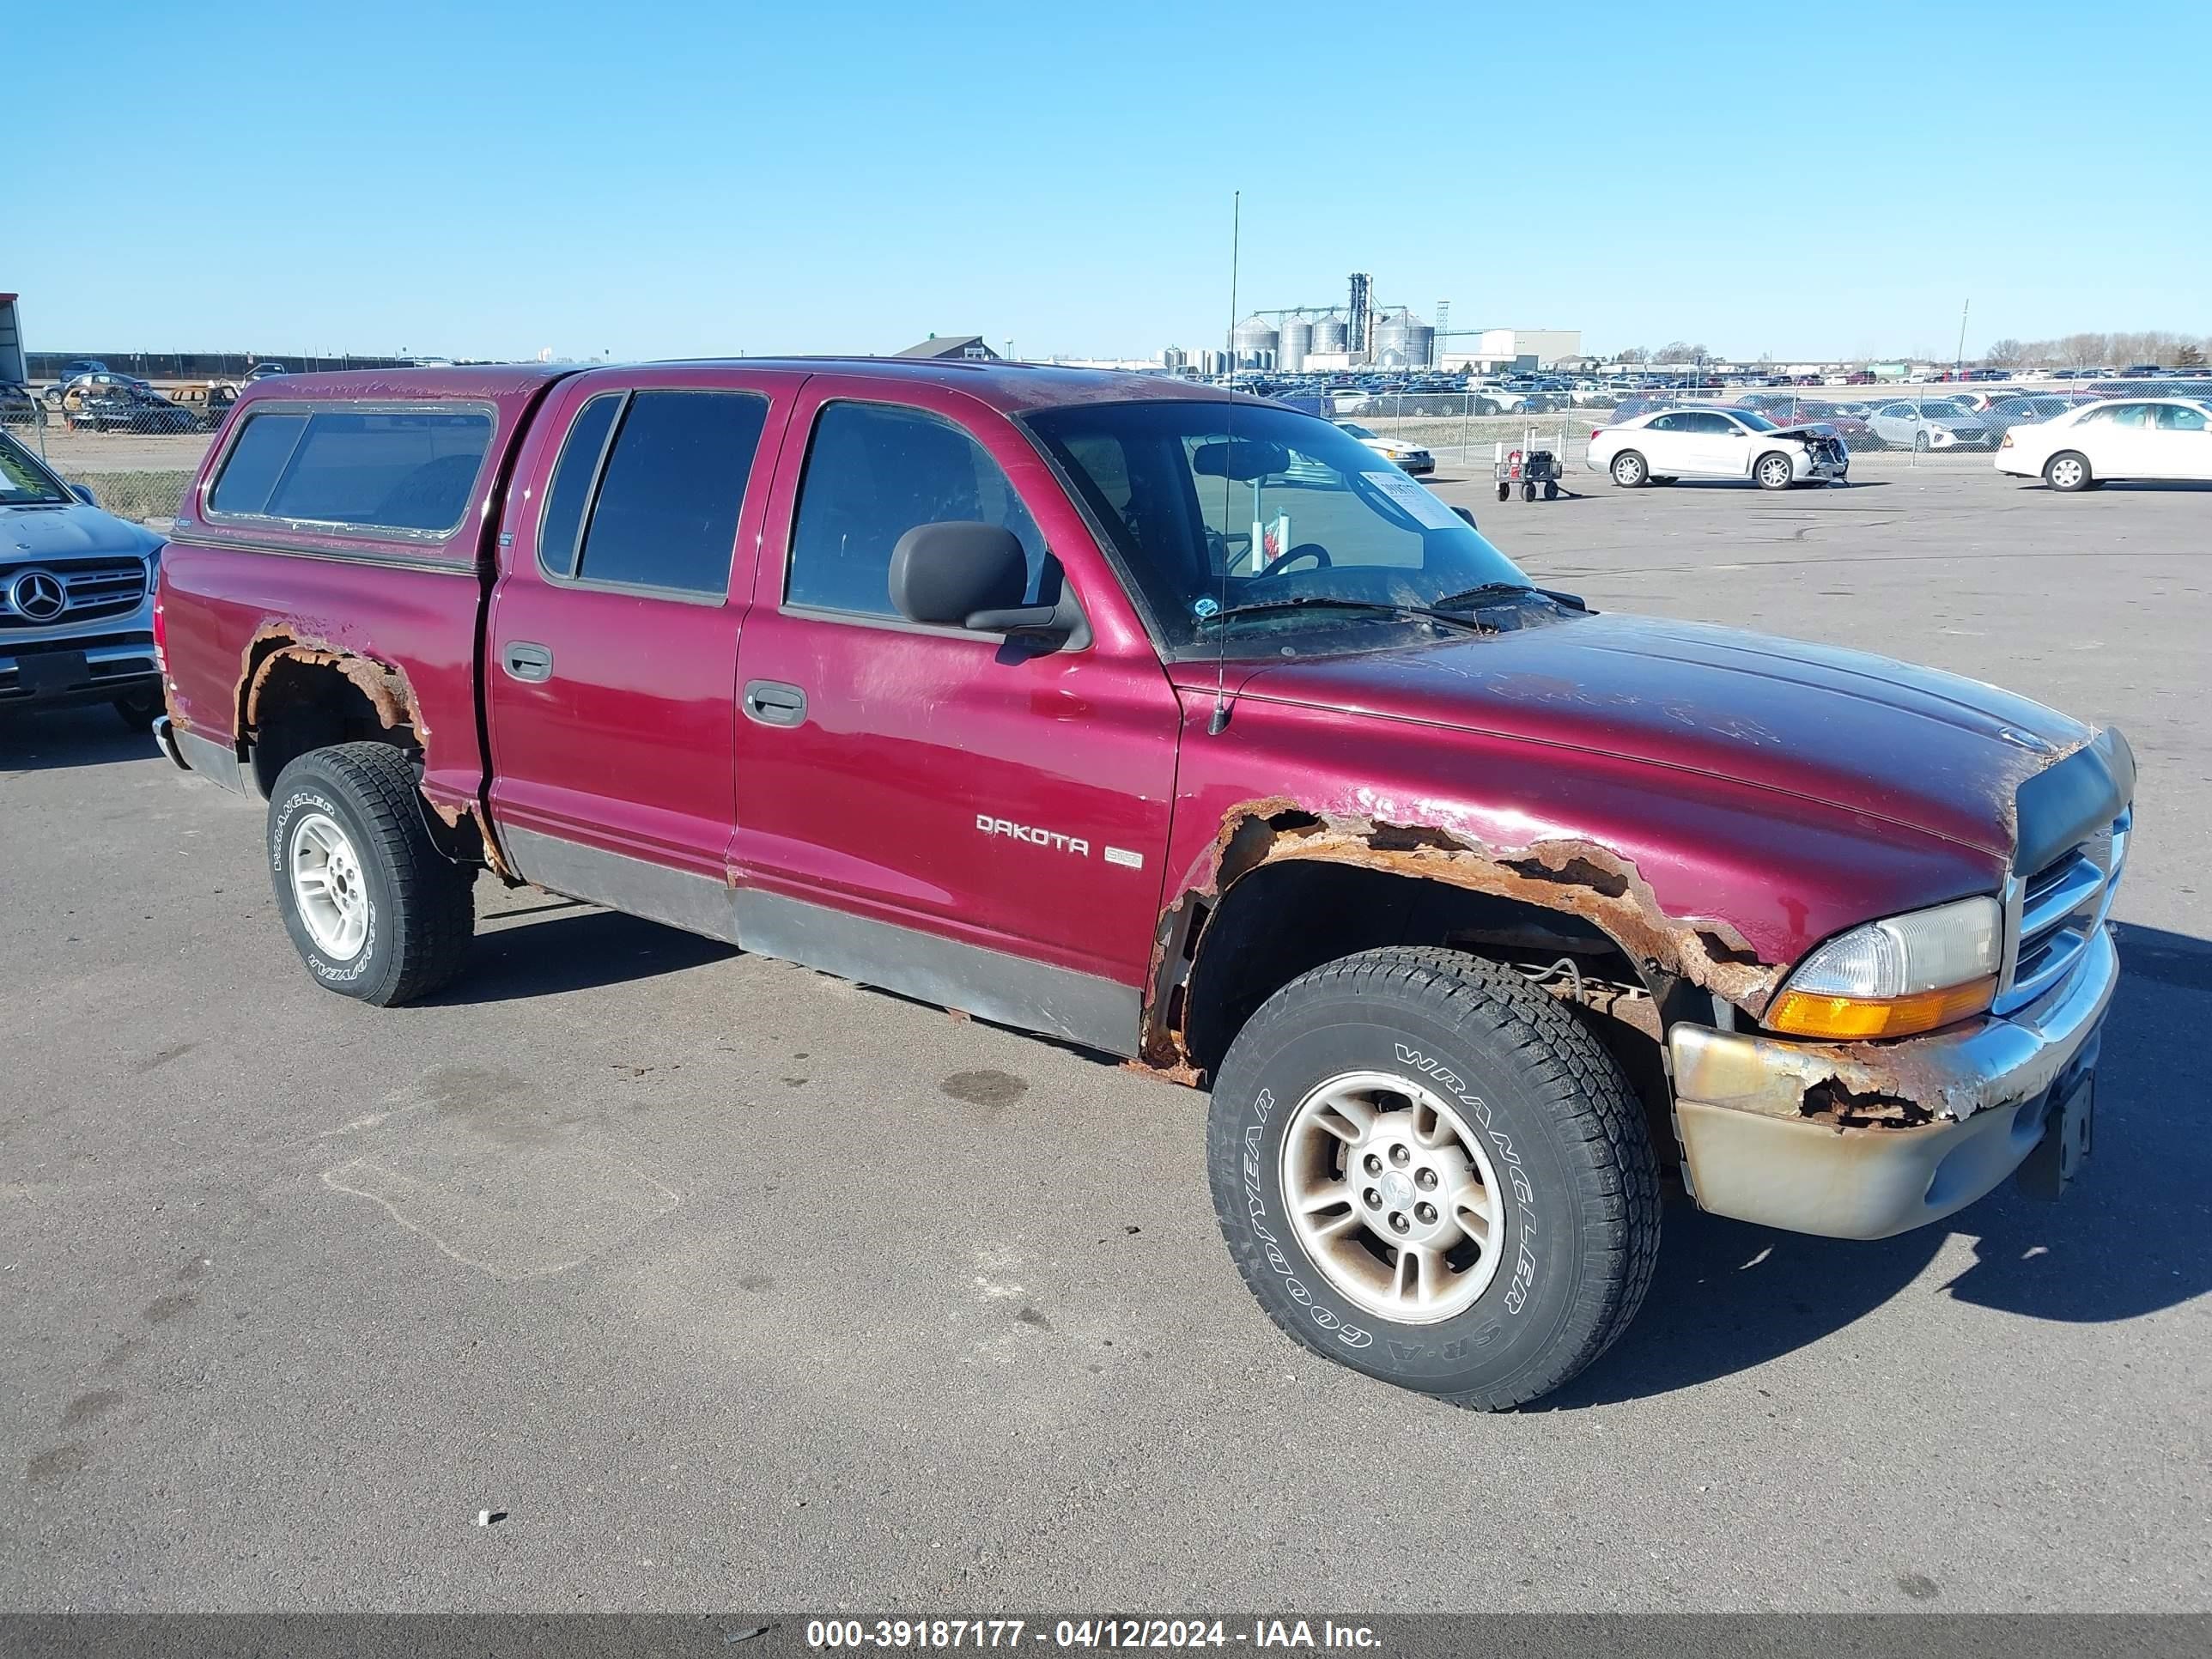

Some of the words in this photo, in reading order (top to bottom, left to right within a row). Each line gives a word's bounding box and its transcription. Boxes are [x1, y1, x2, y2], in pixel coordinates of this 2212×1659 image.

[274, 793, 335, 871] WRANGLER
[976, 813, 1089, 857] DAKOTA
[308, 901, 375, 981] GOODYEAR
[1240, 1088, 1373, 1348] GOODYEAR
[1395, 1043, 1538, 1315] WRANGLER
